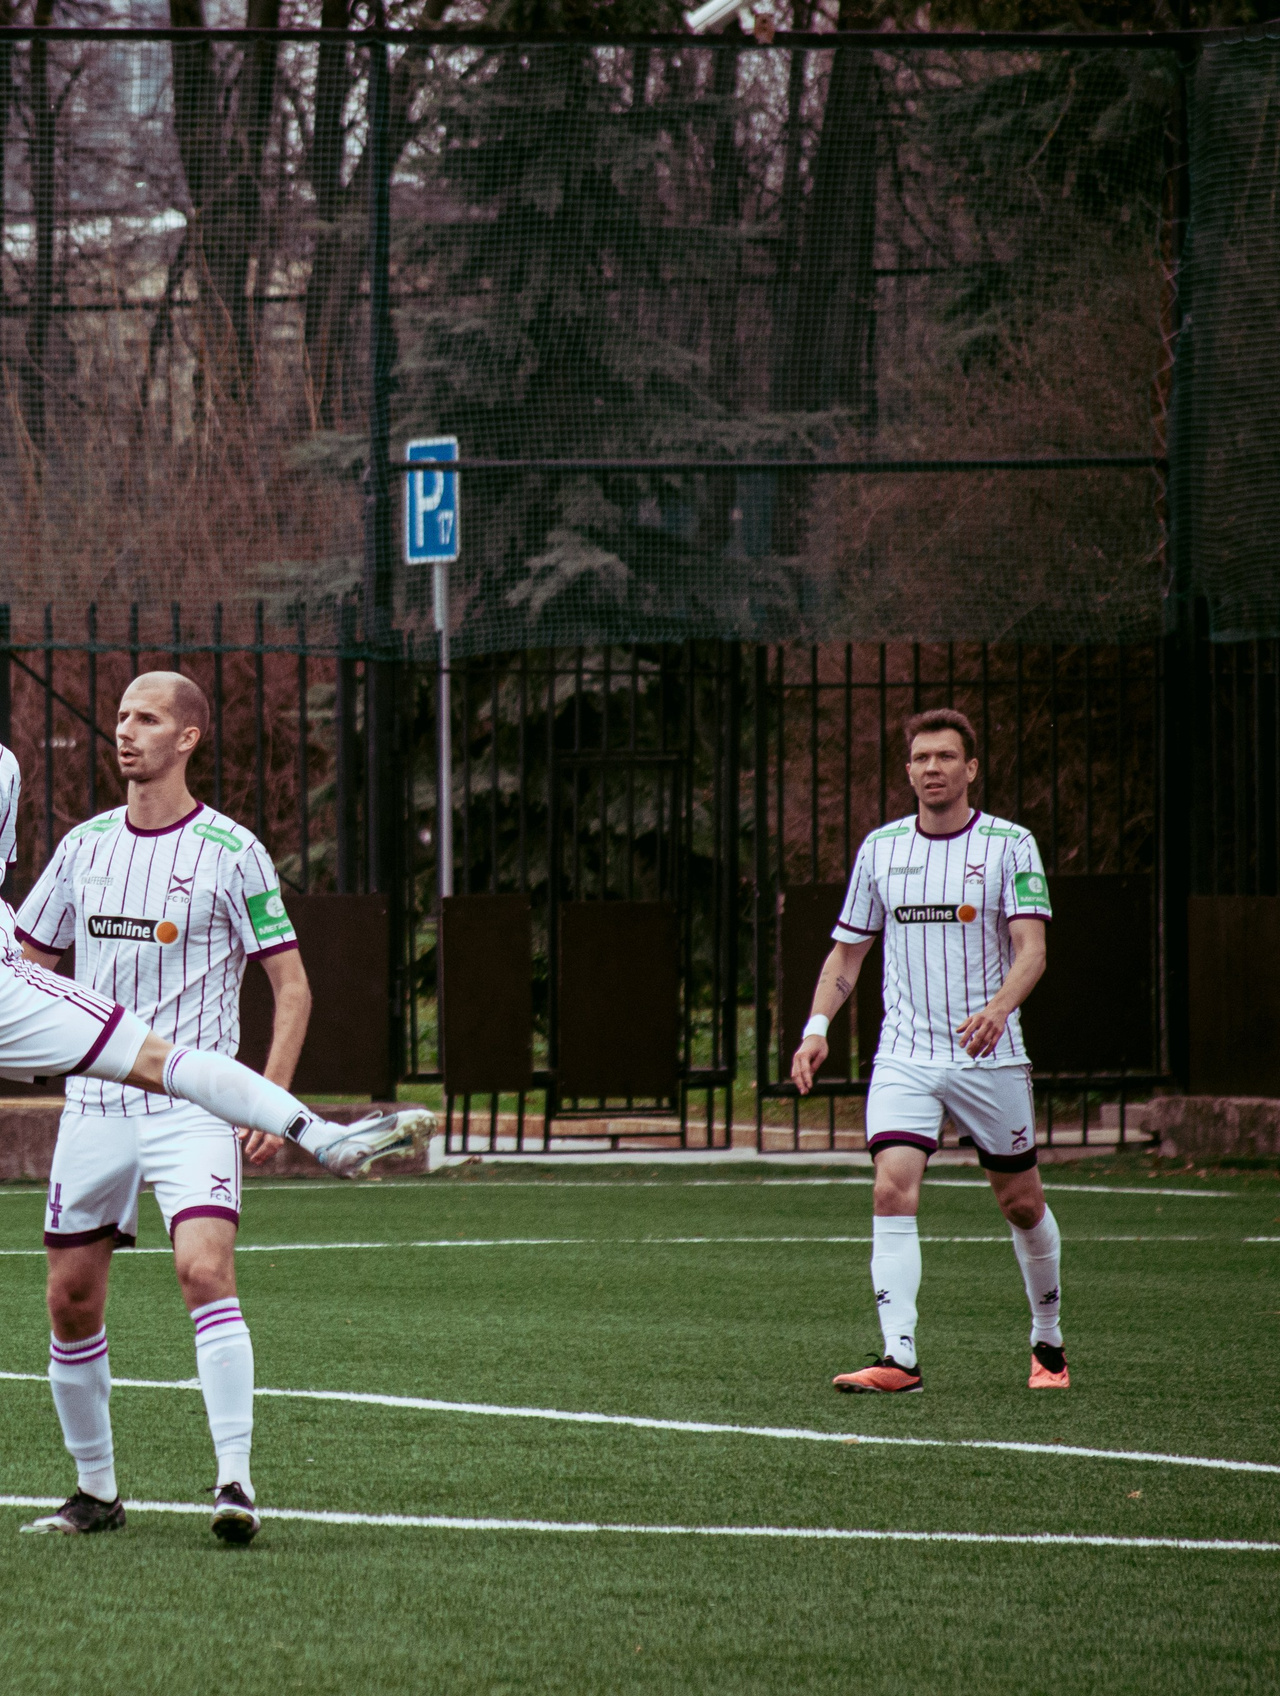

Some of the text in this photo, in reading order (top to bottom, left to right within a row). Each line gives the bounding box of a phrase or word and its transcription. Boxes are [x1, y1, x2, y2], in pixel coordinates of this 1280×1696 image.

[414, 456, 444, 548] P
[437, 508, 454, 546] 17
[91, 919, 152, 939] Winline
[897, 907, 954, 922] Winline
[48, 1181, 63, 1230] 4
